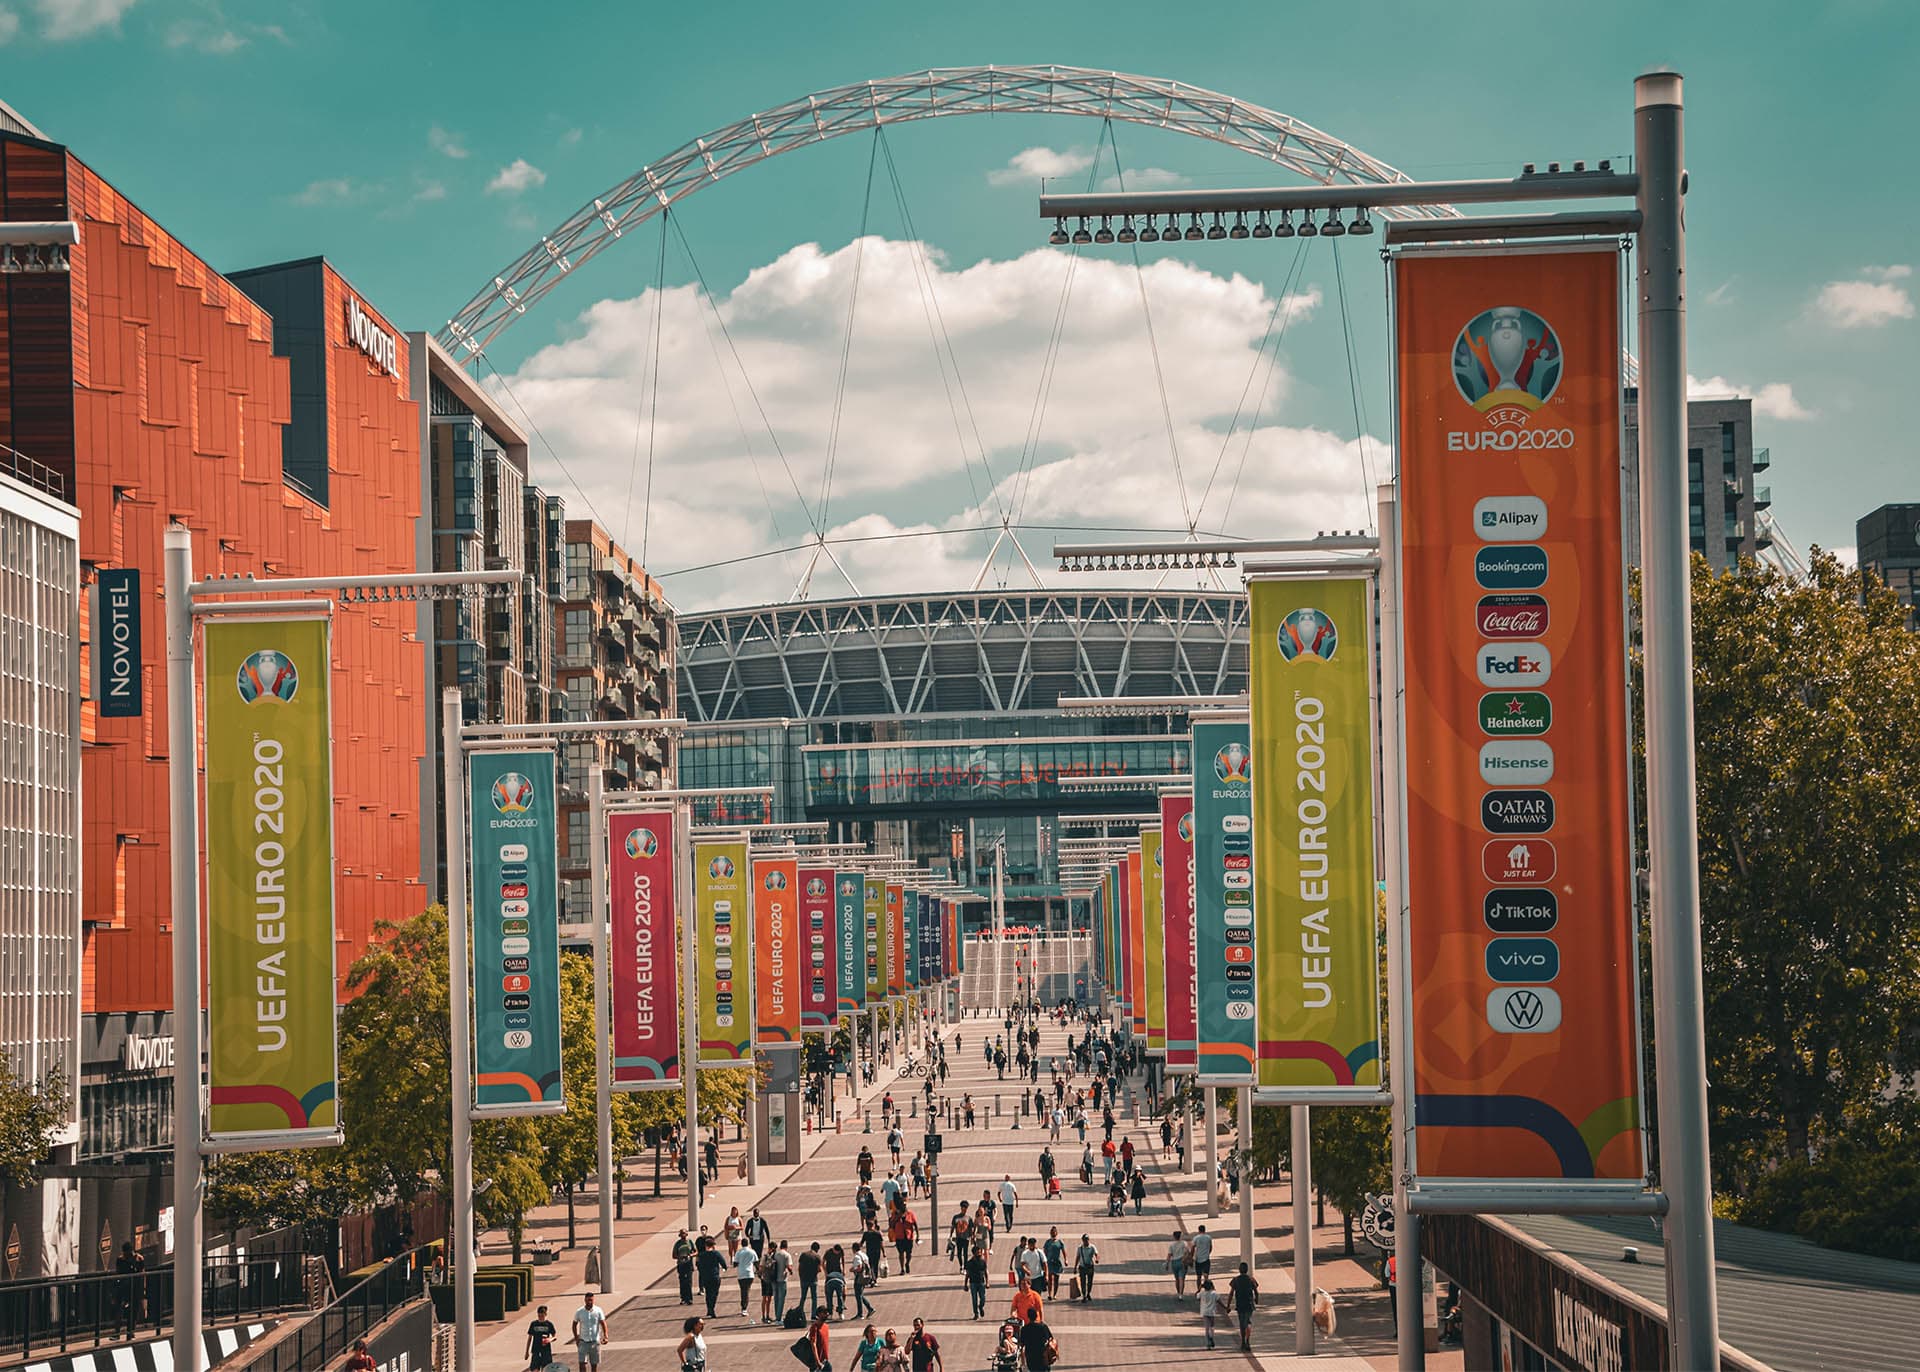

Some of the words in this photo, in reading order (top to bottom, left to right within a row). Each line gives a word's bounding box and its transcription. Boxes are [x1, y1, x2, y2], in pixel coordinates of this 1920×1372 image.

[350, 295, 400, 379] NOVOTEL
[1488, 410, 1527, 427] UEFA
[1448, 428, 1575, 451] EURO2020
[1499, 512, 1539, 525] Alipay
[1479, 560, 1545, 573] Booking.com
[110, 578, 130, 696] NOVOTEL
[1486, 656, 1541, 674] FedEx
[1487, 716, 1544, 728] Heineken
[1295, 696, 1326, 792] 2020
[879, 765, 987, 788] WELCOME
[1484, 757, 1549, 768] Hisense
[253, 739, 284, 834] 2020
[1489, 799, 1546, 817] QATAR
[1502, 814, 1547, 823] AIRWAYS
[1298, 799, 1329, 901] EURO
[255, 841, 286, 944] EURO
[634, 875, 652, 926] 2020
[770, 902, 783, 938] 2020
[844, 904, 853, 932] 2020
[1505, 906, 1552, 918] TikTok
[635, 928, 653, 984] EURO
[771, 939, 783, 978] EURO
[844, 932, 854, 961] EURO
[1301, 908, 1333, 1008] UEFA
[1499, 952, 1546, 965] vivo
[845, 960, 854, 990] UEFA
[257, 950, 287, 1052] UEFA
[637, 986, 655, 1040] UEFA
[772, 978, 784, 1015] UEFA
[128, 1033, 175, 1071] NOVOTE
